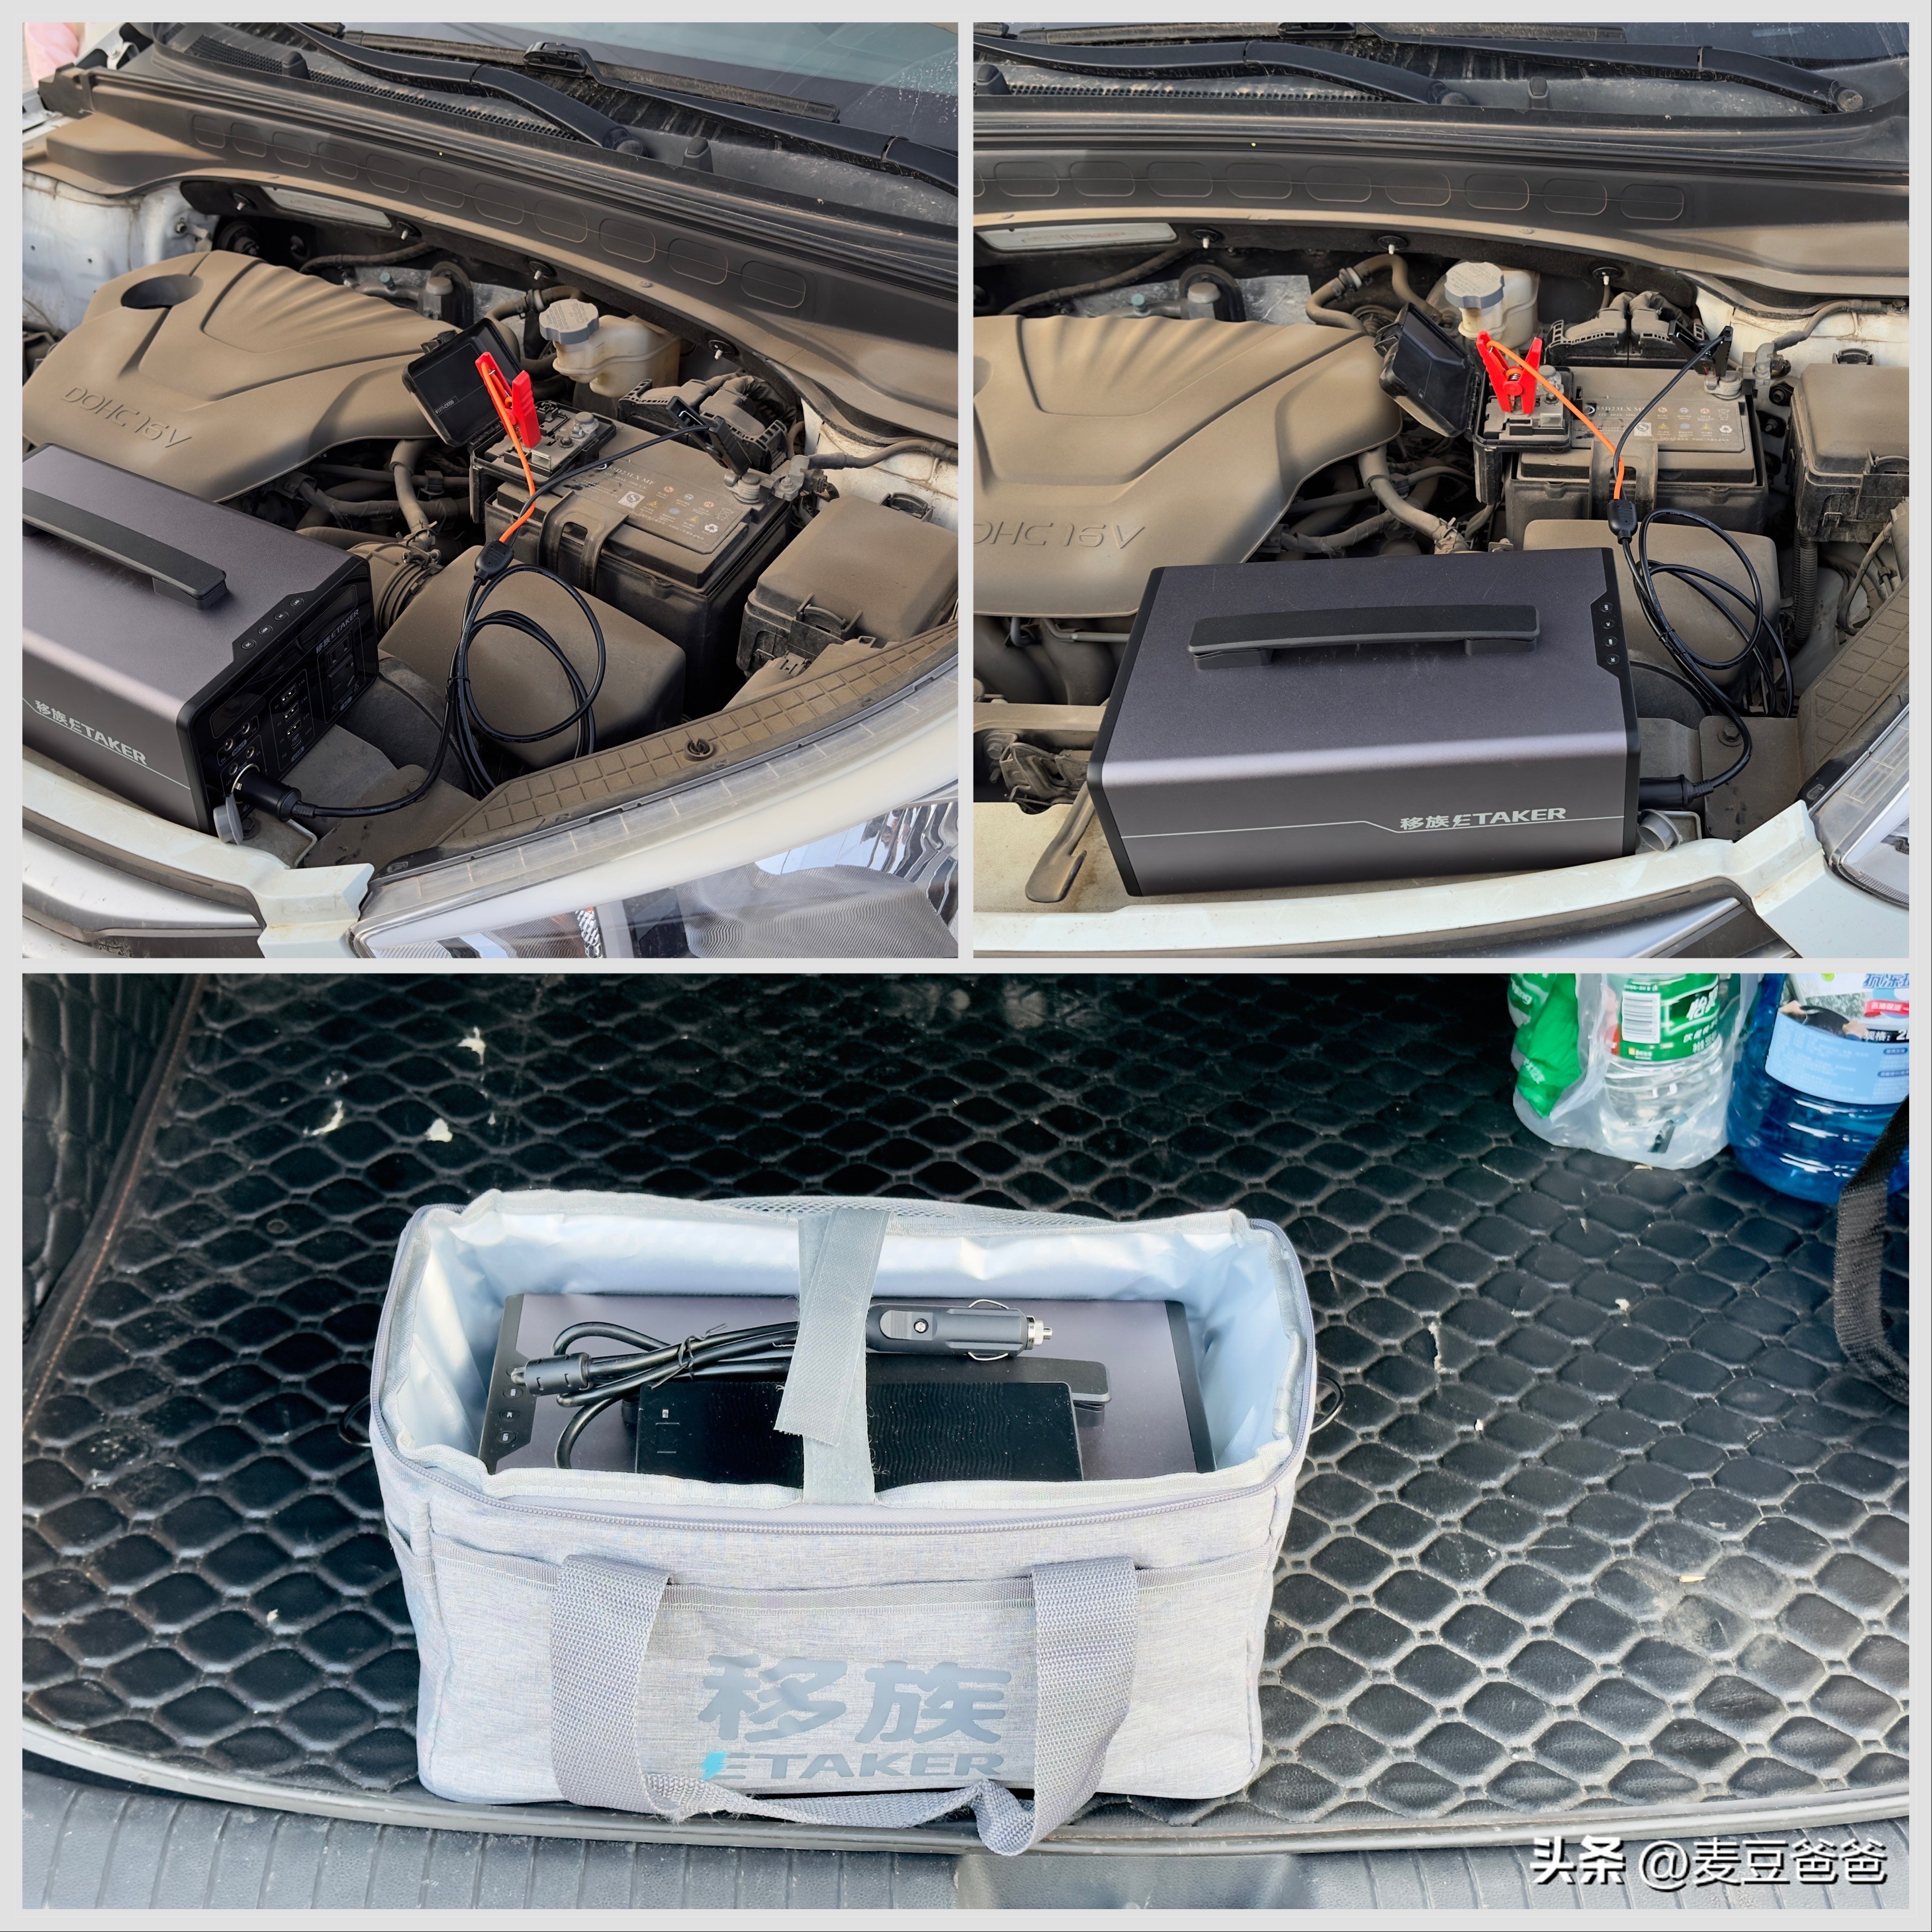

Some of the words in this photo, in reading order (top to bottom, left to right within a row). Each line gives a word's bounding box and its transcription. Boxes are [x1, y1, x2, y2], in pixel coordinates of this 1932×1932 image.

[62, 385, 140, 427] DOHC
[134, 417, 192, 448] 16V
[435, 400, 454, 414] 91971-C9200
[1064, 522, 1145, 549] 16V
[331, 609, 359, 638] ETAKER
[35, 700, 68, 726] 移族
[69, 718, 147, 766] ETAKER
[233, 742, 246, 756] INPUT
[1400, 815, 1449, 830] 移族
[1452, 808, 1566, 827] ETAKER
[698, 1654, 1011, 1744] 移族
[701, 1751, 1004, 1780] ETAKER
